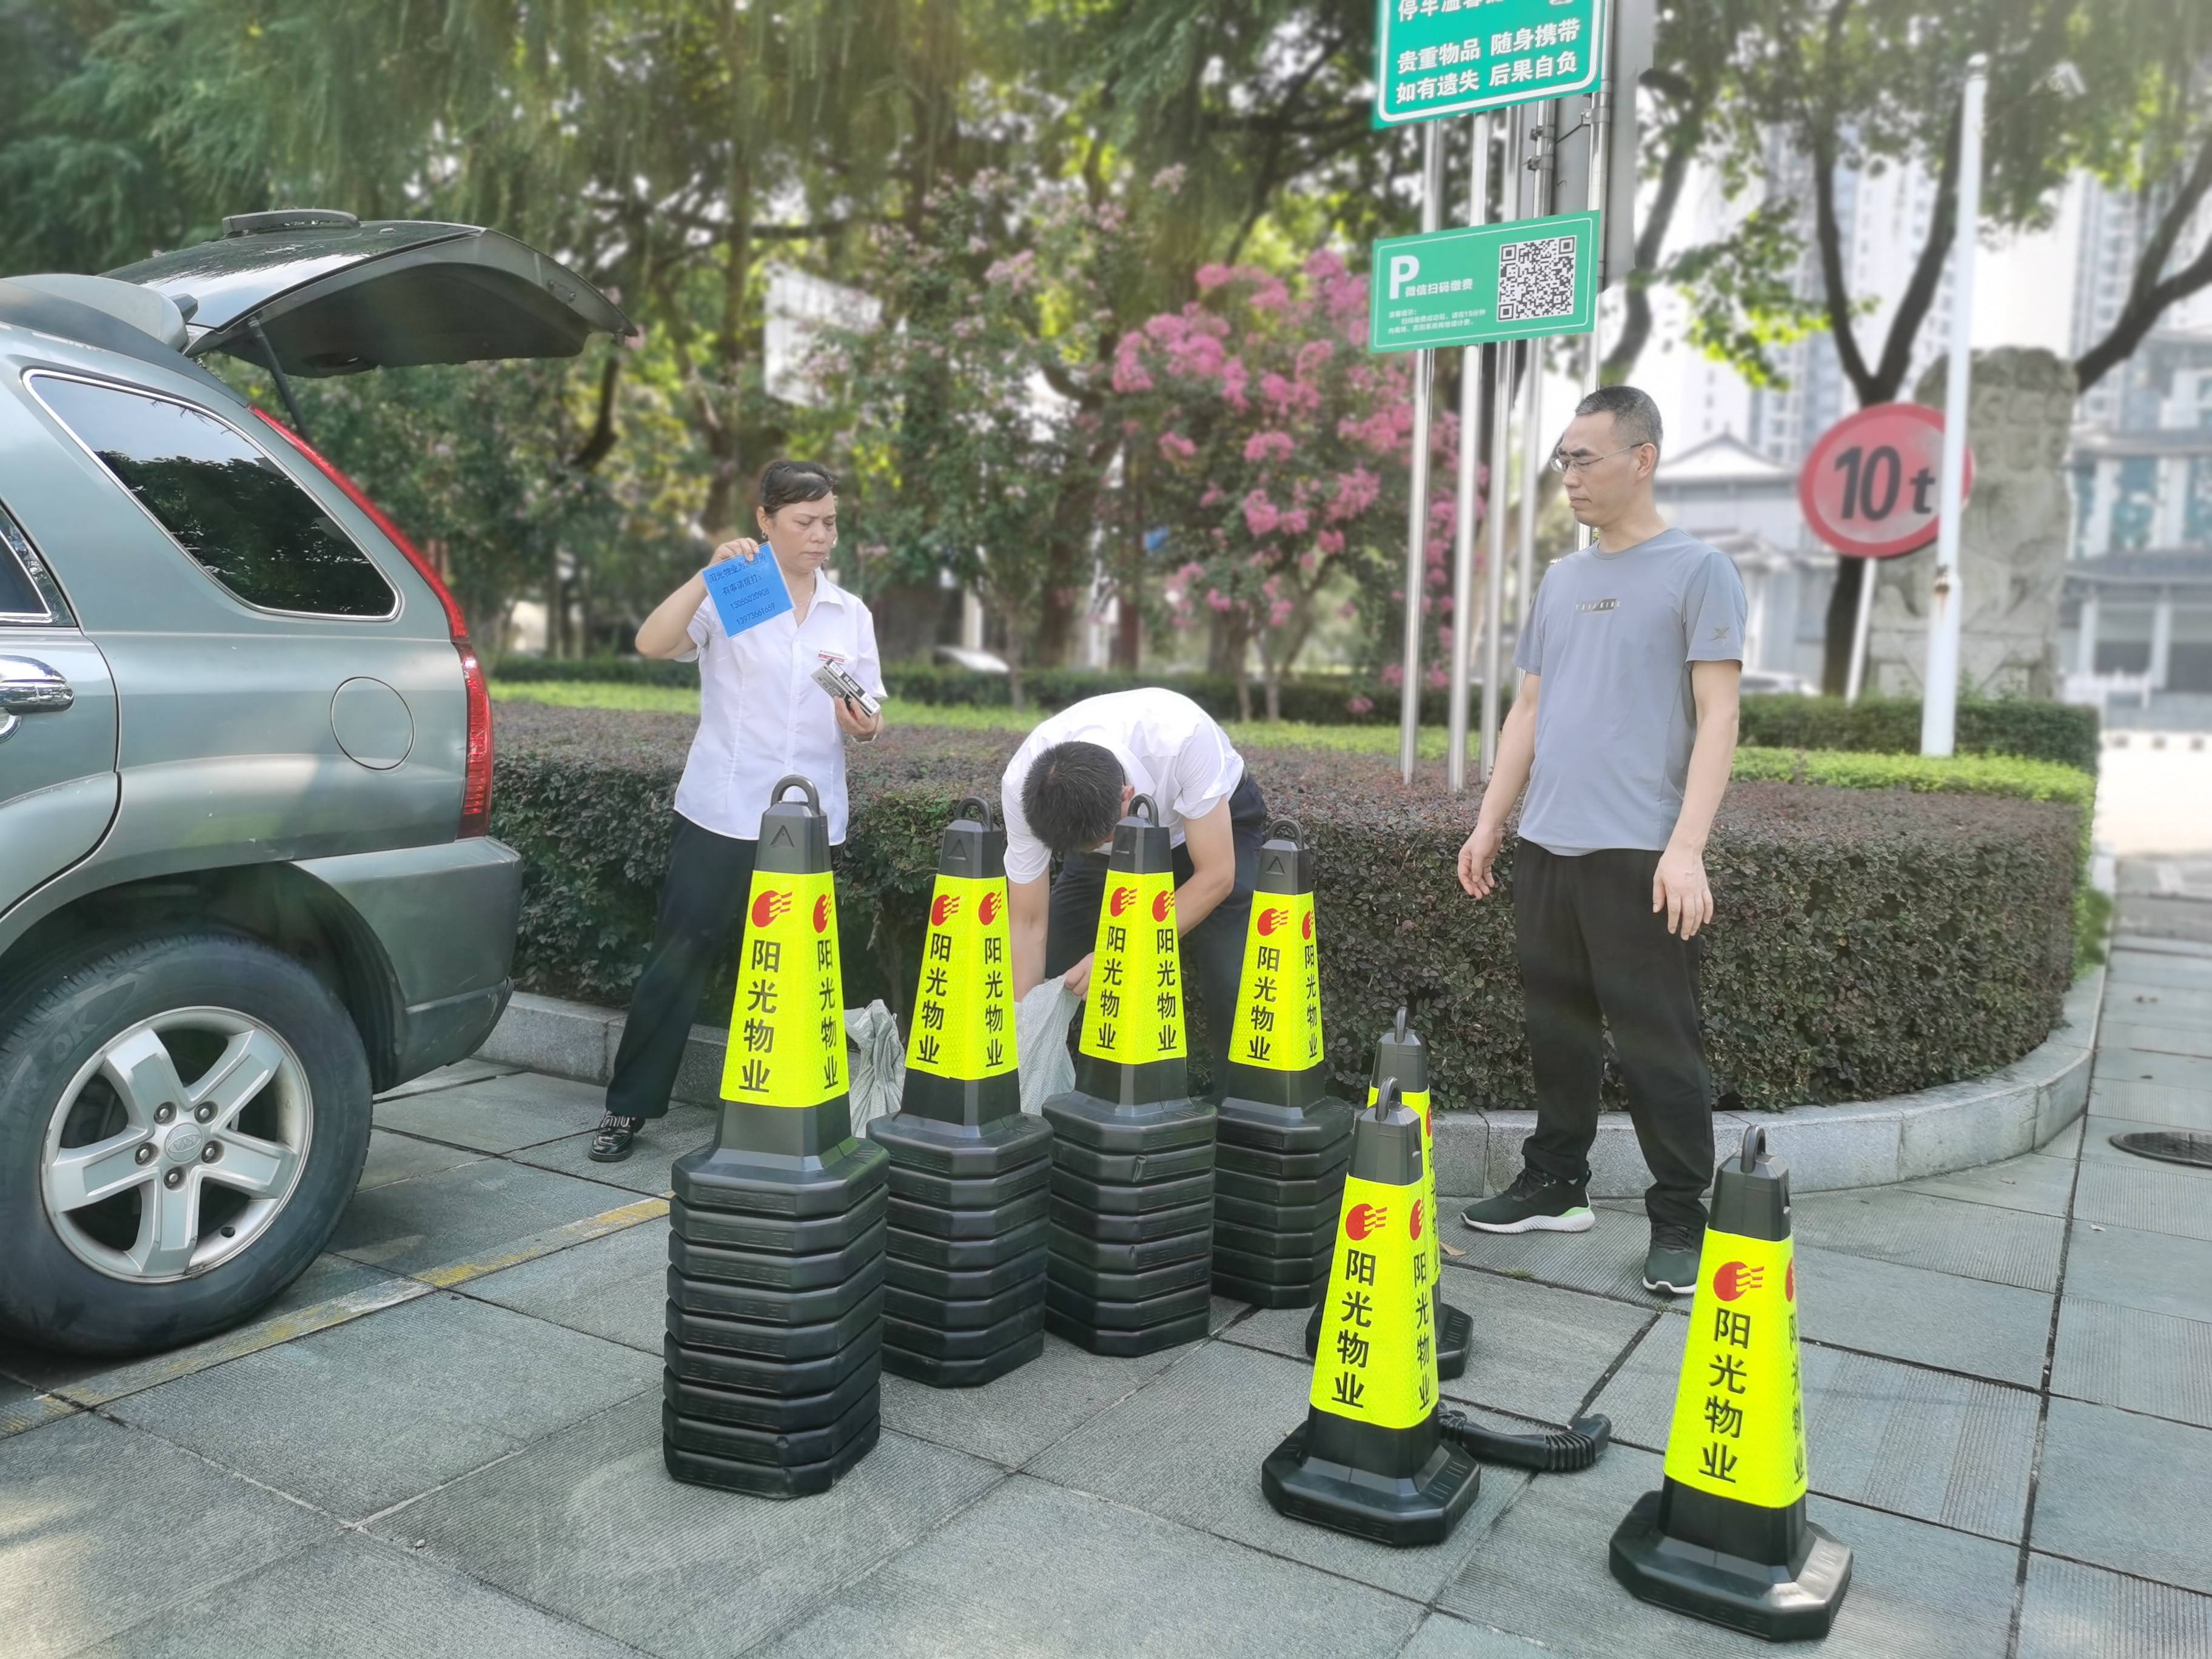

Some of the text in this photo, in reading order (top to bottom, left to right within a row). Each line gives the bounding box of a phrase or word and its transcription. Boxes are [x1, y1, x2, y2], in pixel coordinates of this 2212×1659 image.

[1396, 51, 1577, 104] 如有遗失 后果自负
[1397, 18, 1580, 74] 贵重物品 随身携带
[1389, 255, 1419, 300] P
[1405, 278, 1473, 298] 微信扫码缴费
[708, 553, 766, 583] 阳光物业为务
[739, 939, 781, 1093] 阳光物业
[817, 939, 839, 1089] 阳光物业
[916, 933, 952, 1064] 阳光物业
[984, 937, 1004, 1067] 阳光物业
[1096, 925, 1126, 1050] 阳光物业
[1156, 928, 1177, 1051] 阳光物业
[1247, 945, 1280, 1061] 阳光物业
[1304, 944, 1318, 1058] 阳光物业
[1331, 1249, 1376, 1409] 阳光物业
[1413, 1252, 1430, 1411] 阳光物业
[1698, 1307, 1751, 1483] 阳光物业
